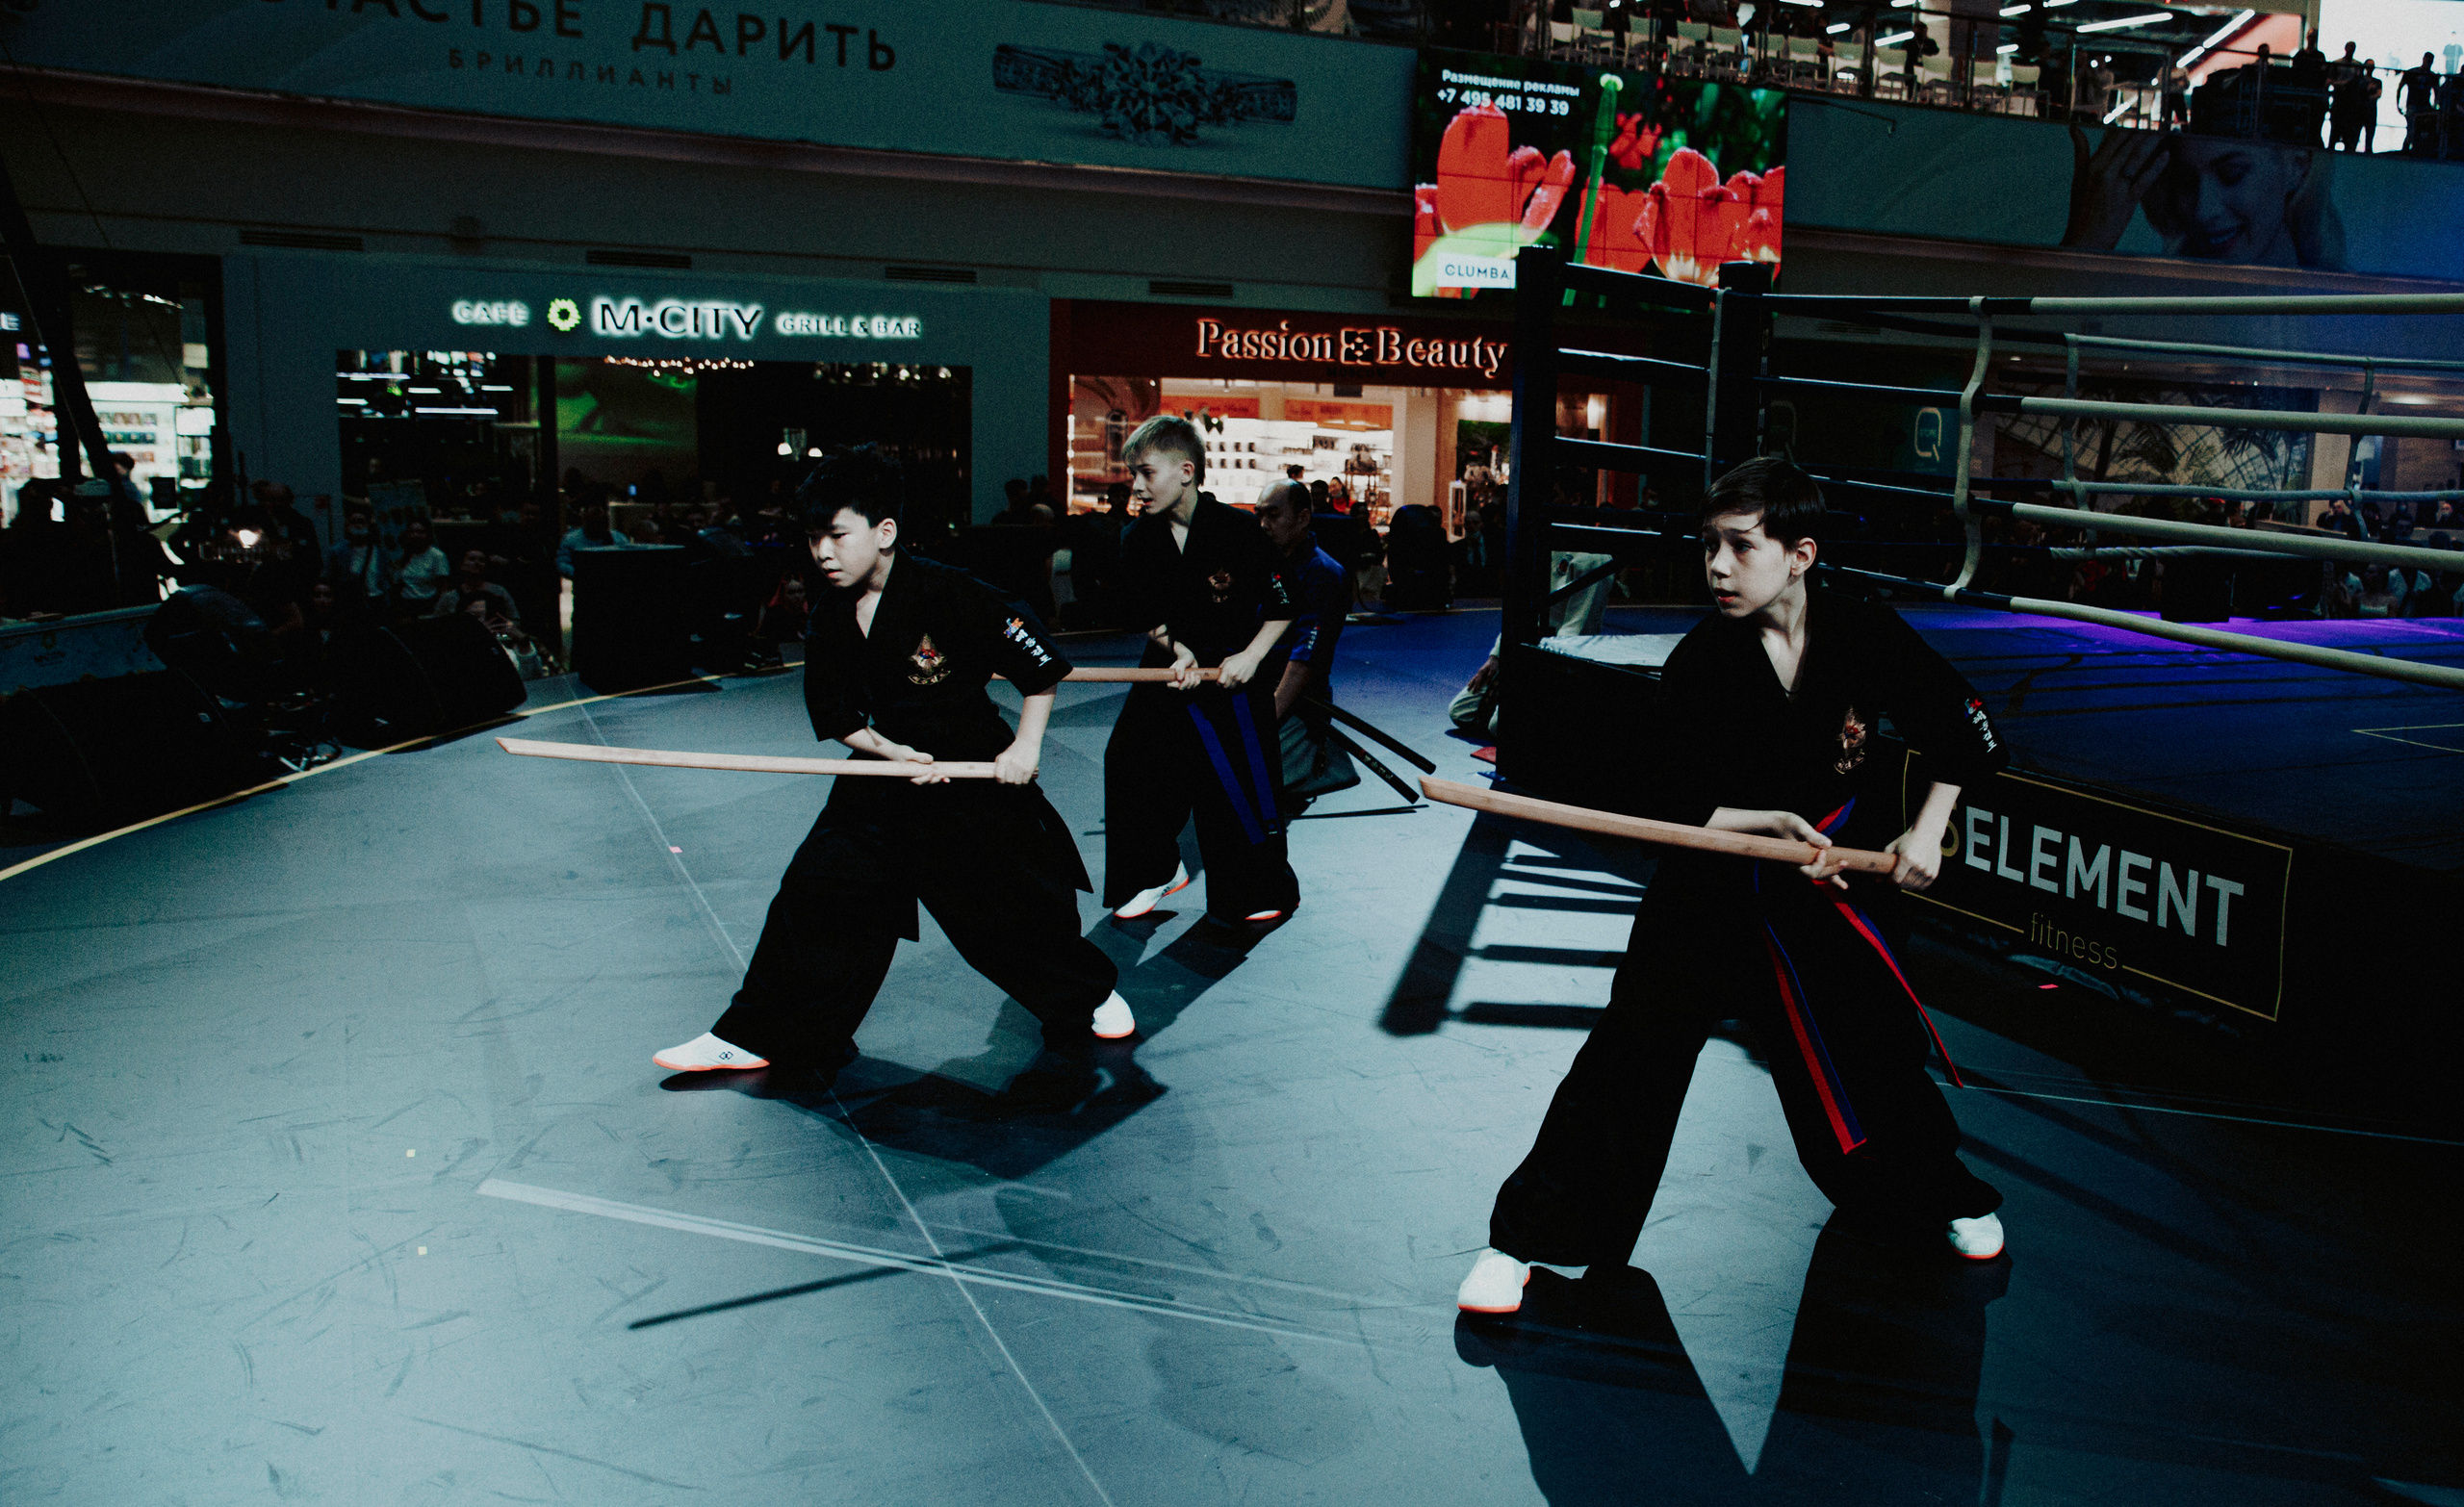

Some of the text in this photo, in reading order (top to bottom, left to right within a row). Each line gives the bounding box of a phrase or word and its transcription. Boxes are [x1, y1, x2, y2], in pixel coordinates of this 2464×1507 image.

[262, 0, 896, 71] СТЬЕ ДАРИТЬ
[449, 48, 732, 94] БРИЛЛИАНТЫ
[1442, 69, 1580, 97] Размещение рекламы
[1437, 88, 1570, 116] +7 495 481 39 39
[1445, 264, 1510, 280] CLUMBA
[1196, 318, 1508, 379] Passion Beauty
[2029, 912, 2118, 970] fitness
